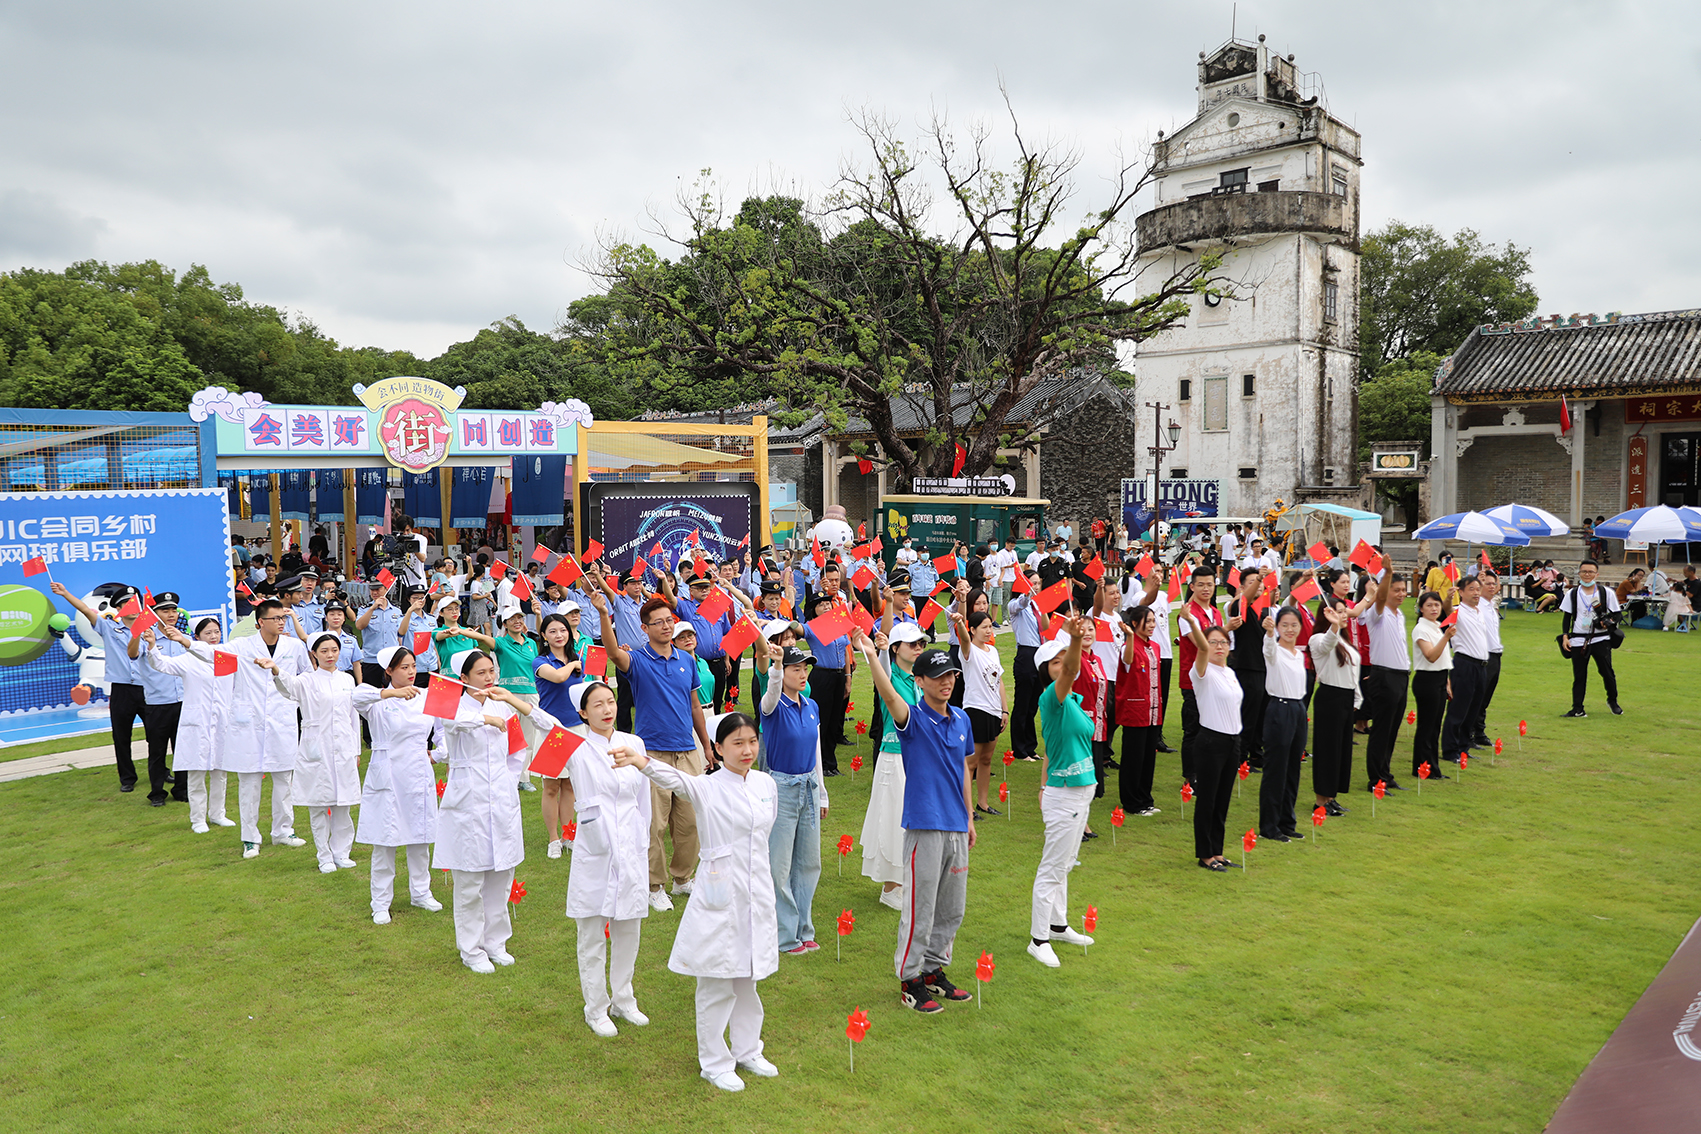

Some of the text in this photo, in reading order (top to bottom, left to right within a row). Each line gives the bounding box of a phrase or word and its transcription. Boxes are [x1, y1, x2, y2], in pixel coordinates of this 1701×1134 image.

[377, 382, 445, 401] 会不同 造物街
[249, 409, 554, 457] 会美好 街 同创造
[1125, 482, 1217, 505] HUTONG
[0, 513, 157, 540] IC会同乡村
[0, 538, 148, 567] 网球俱乐部
